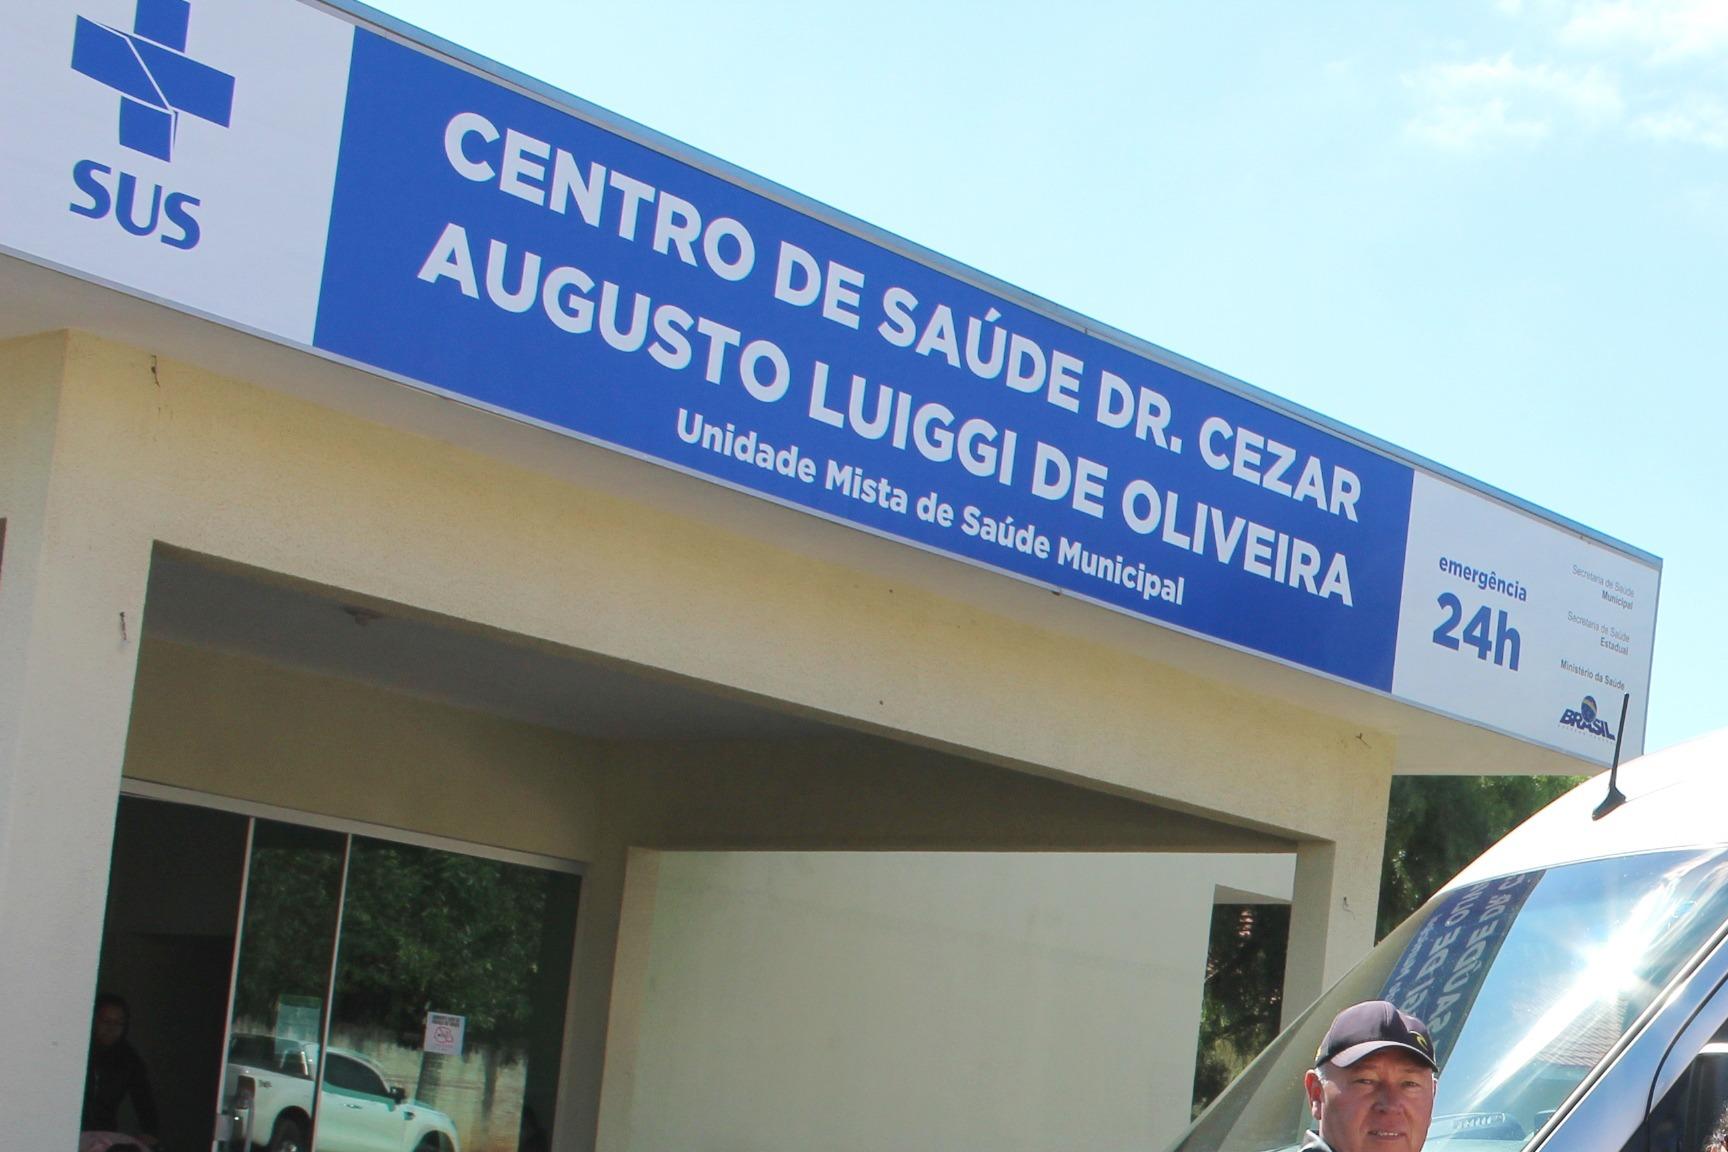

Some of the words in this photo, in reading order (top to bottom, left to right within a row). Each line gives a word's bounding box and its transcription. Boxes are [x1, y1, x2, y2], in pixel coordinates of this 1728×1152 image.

[69, 159, 201, 251] SUS
[444, 111, 755, 281] CENTRO
[774, 240, 865, 330] DE
[877, 286, 1084, 414] SAÚDE
[1096, 369, 1183, 454] DR.
[1198, 416, 1361, 523] CEZAR
[416, 222, 790, 403] AUGUSTO
[808, 360, 1017, 486] LUIGGI
[1031, 440, 1109, 519] DE
[1121, 479, 1353, 607] OLIVEIRA
[676, 407, 817, 483] Unidade
[824, 459, 908, 514] Mista
[916, 491, 954, 527] de
[960, 505, 1050, 559] Saúde
[1057, 536, 1185, 605] Municipal
[1438, 556, 1528, 602] emergência
[1432, 591, 1522, 672] 24h
[1559, 707, 1617, 742] BRASIL
